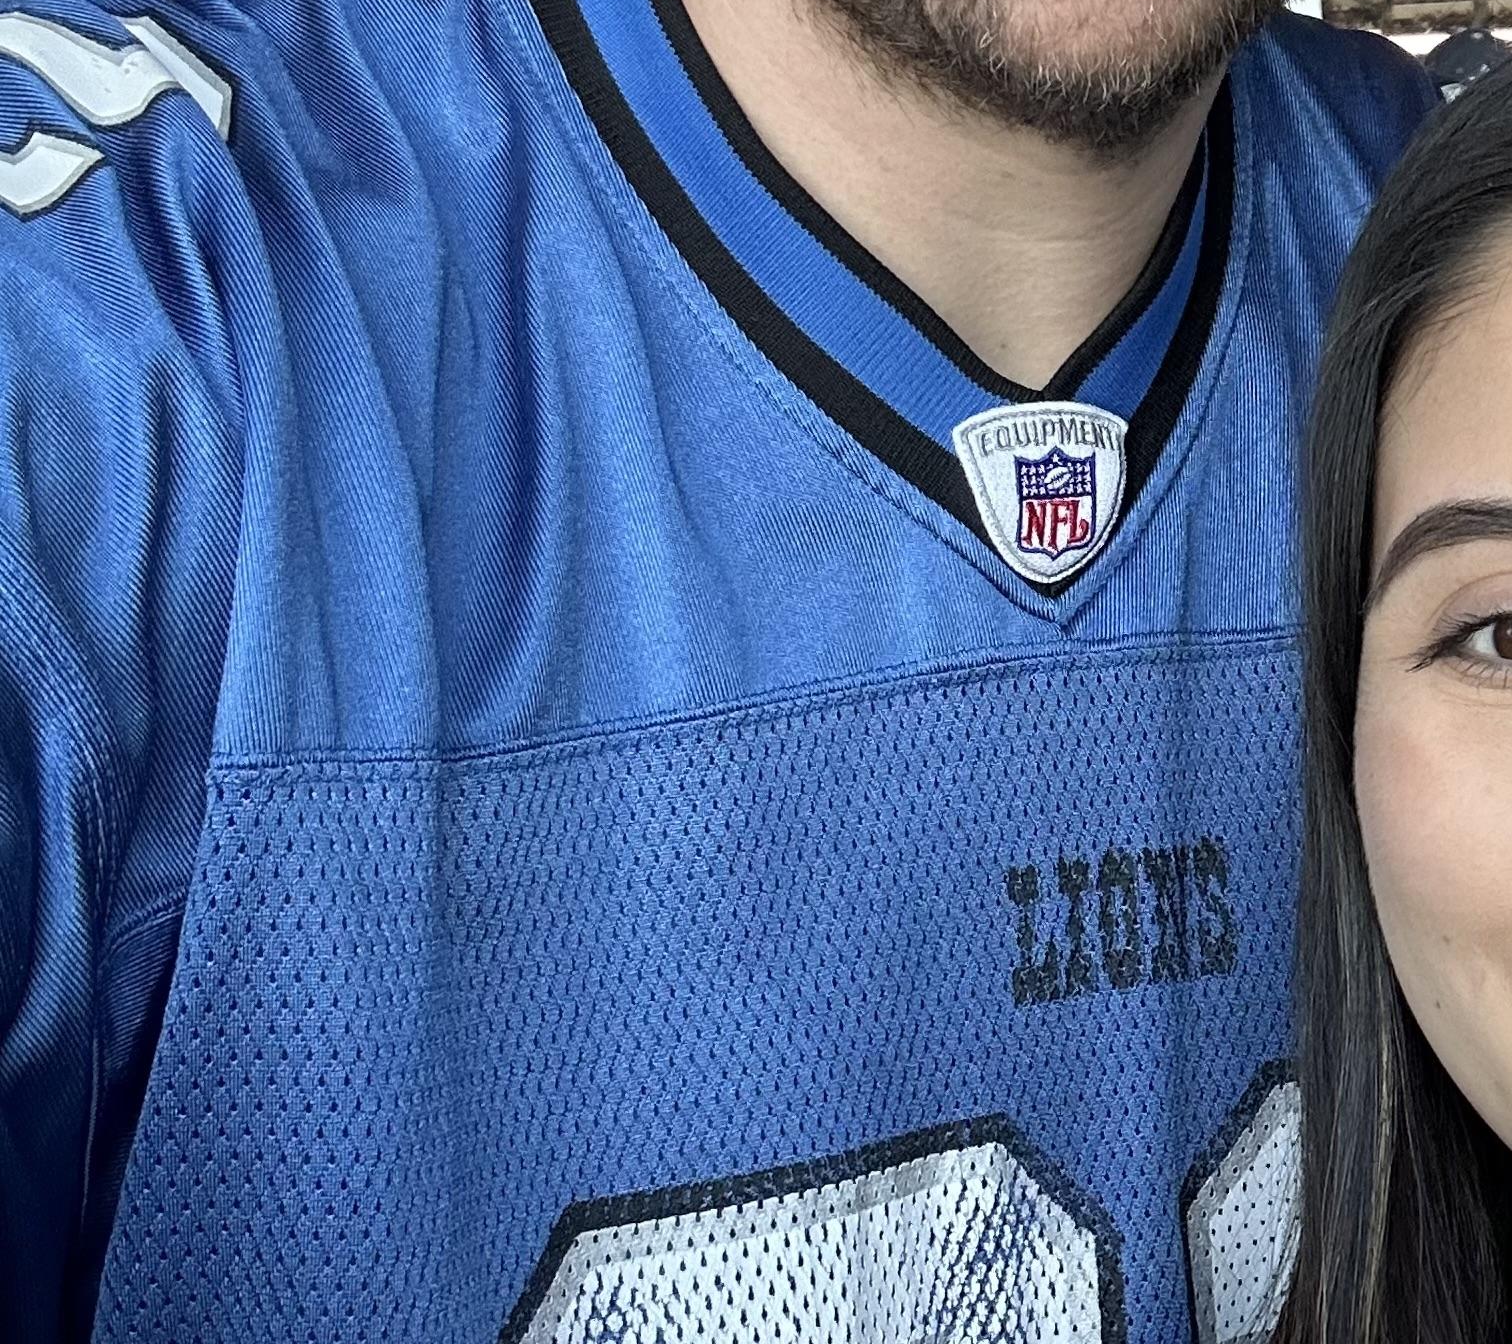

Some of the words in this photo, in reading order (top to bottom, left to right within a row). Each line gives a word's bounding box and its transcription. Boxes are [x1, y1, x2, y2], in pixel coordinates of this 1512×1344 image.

[981, 416, 1119, 456] EQUIPMENT
[1021, 499, 1090, 552] NFL
[1003, 835, 1239, 1009] LIONS
